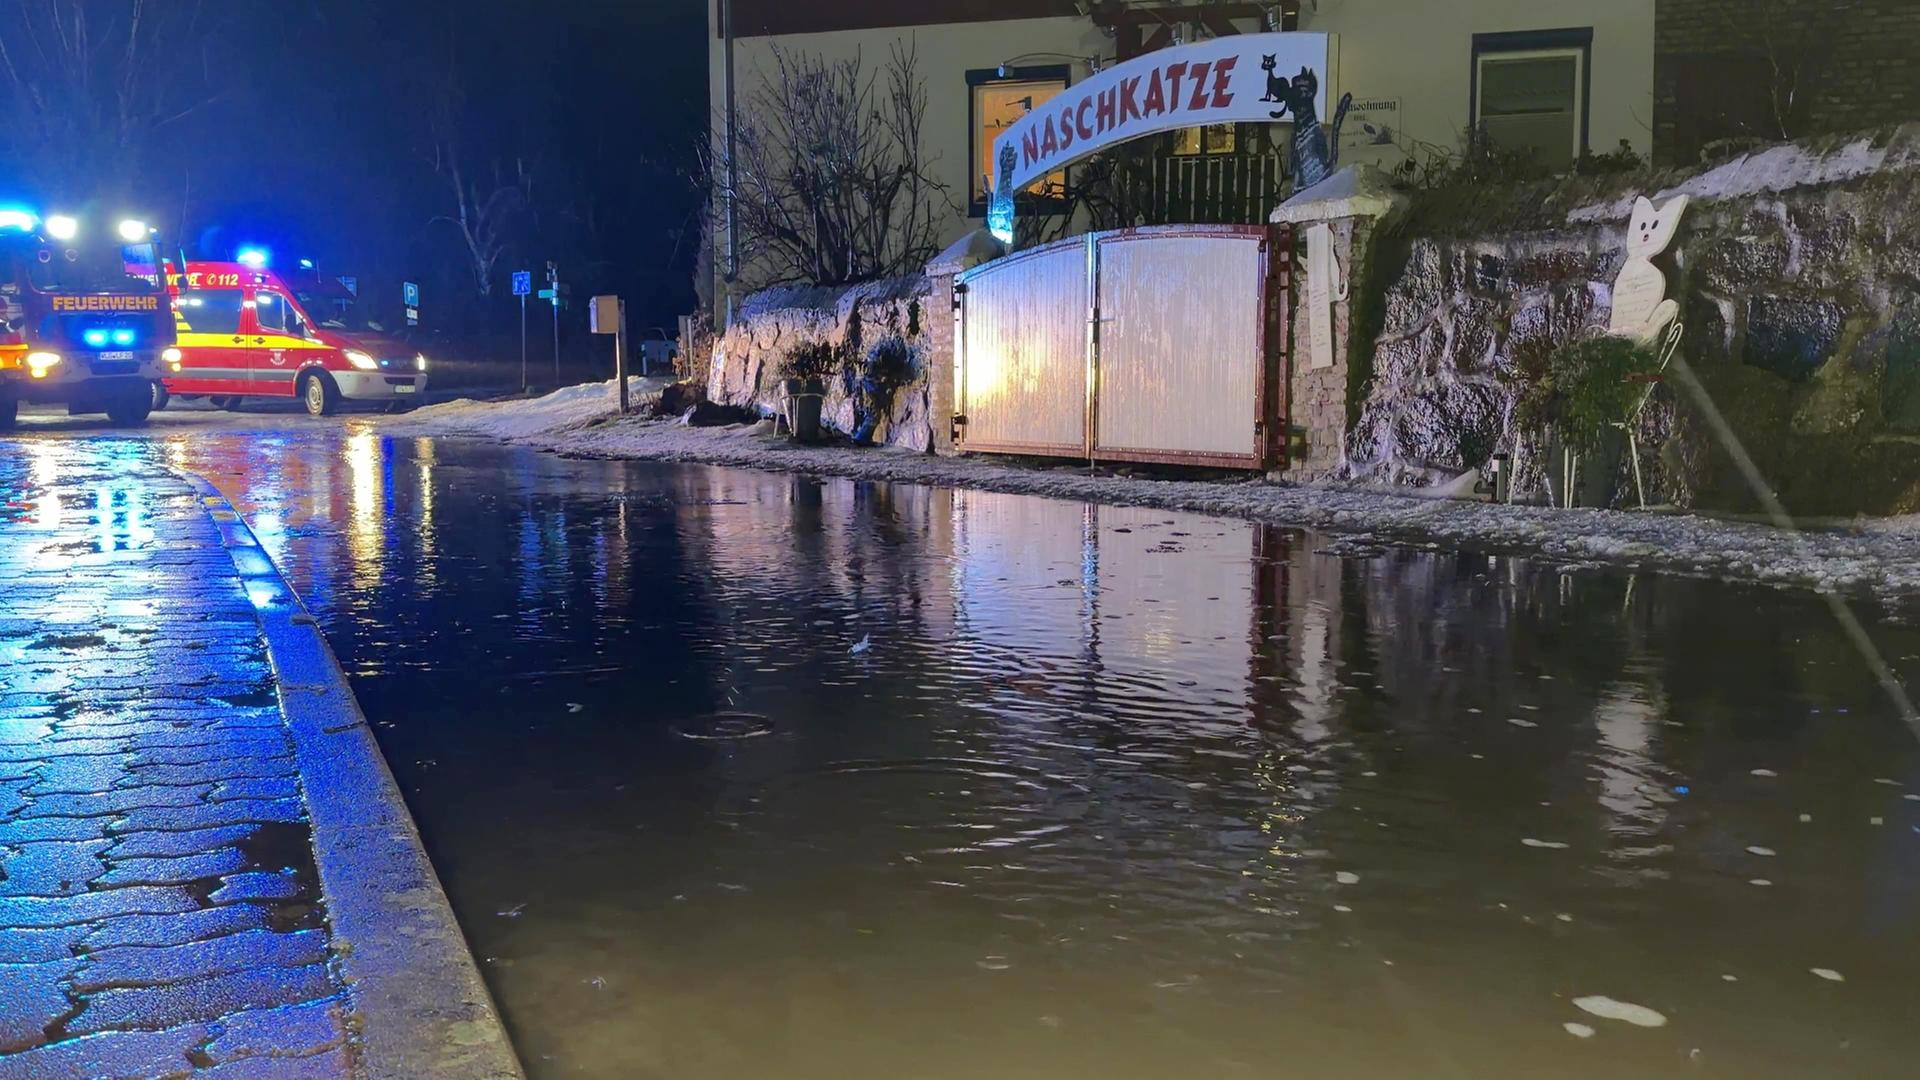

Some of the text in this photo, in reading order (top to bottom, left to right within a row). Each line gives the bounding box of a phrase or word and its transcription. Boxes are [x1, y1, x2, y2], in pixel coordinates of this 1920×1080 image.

[1021, 55, 1239, 170] NASCHKATZE
[219, 273, 239, 286] 112
[53, 296, 158, 310] FEUERWEHR
